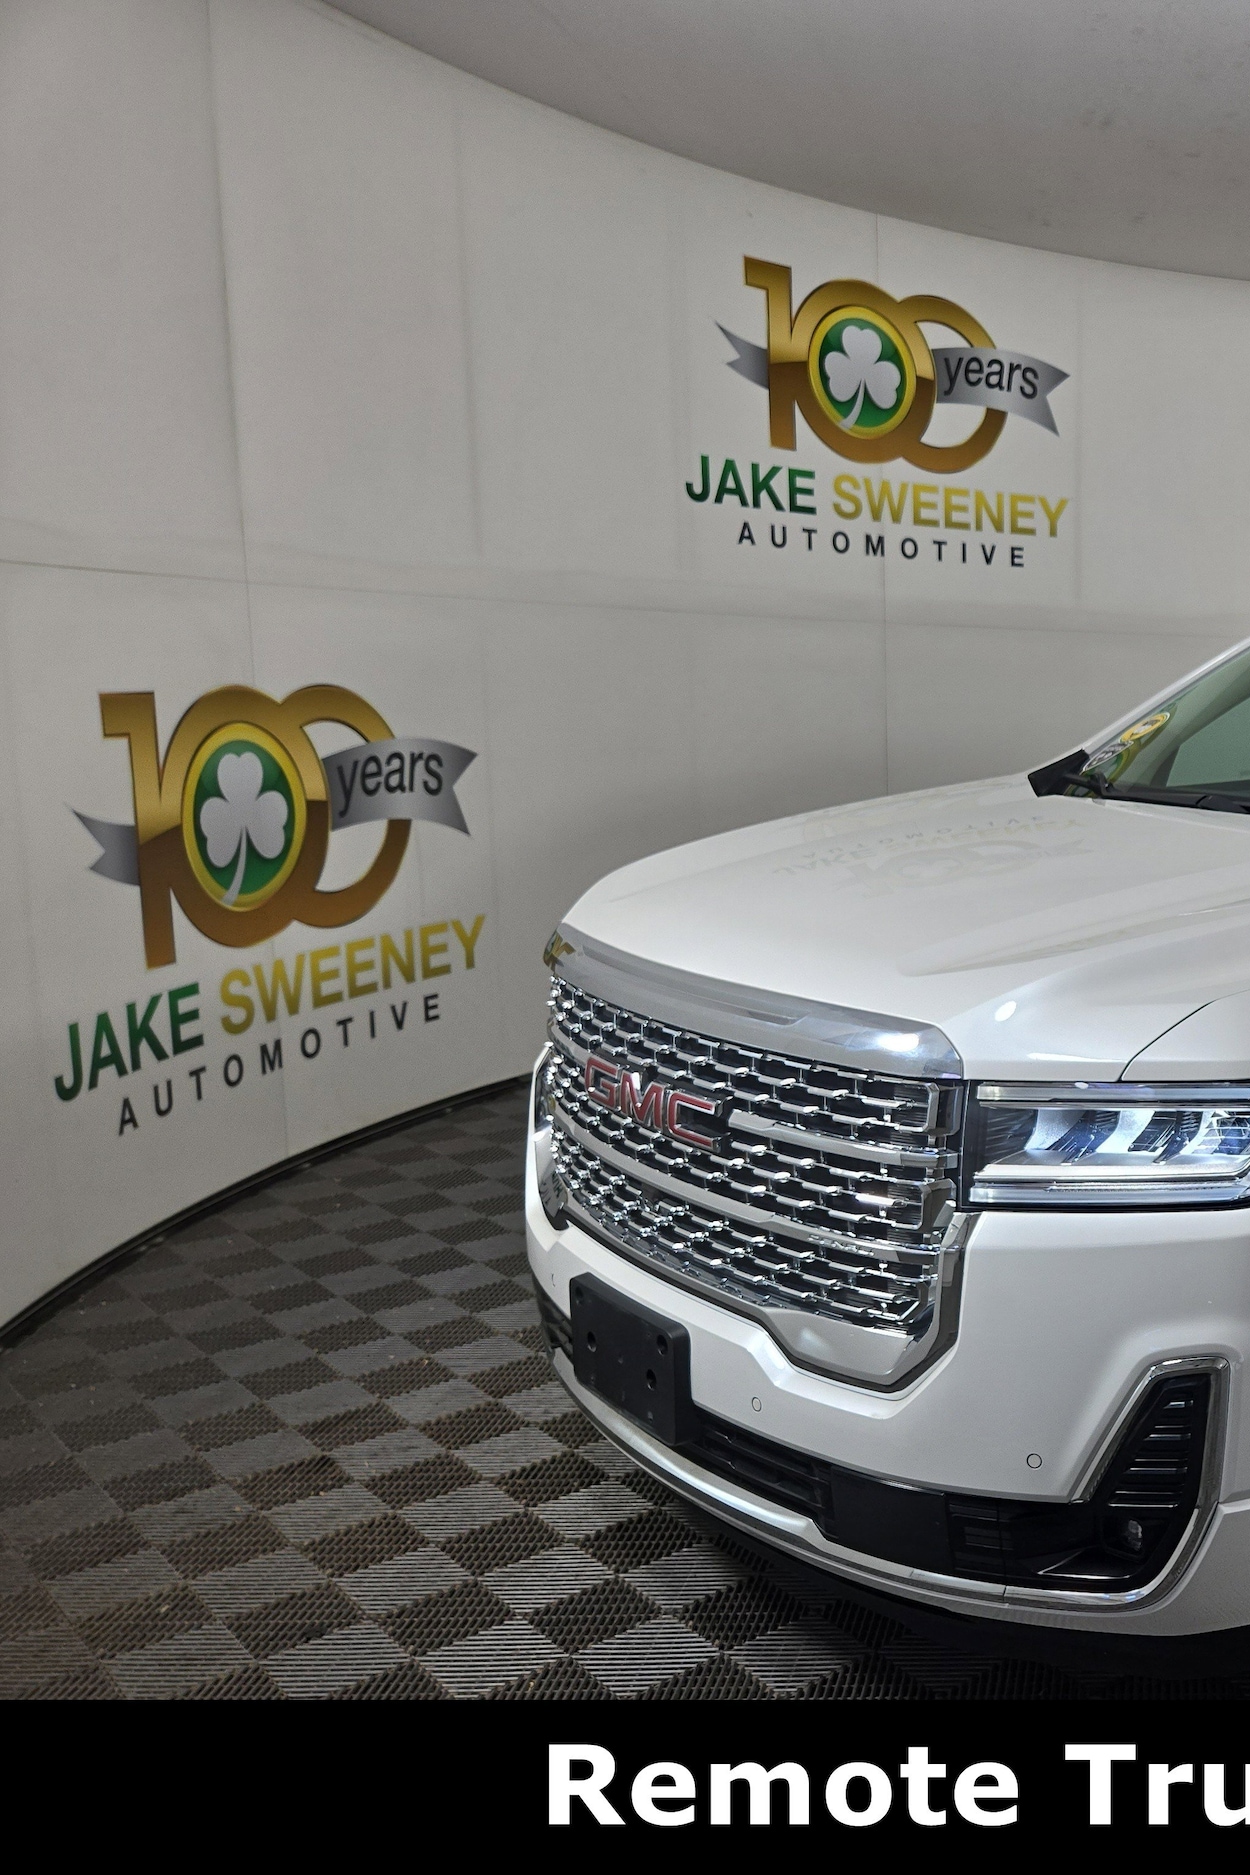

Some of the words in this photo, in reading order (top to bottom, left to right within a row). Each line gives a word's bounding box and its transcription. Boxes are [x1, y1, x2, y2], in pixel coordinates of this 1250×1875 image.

[943, 354, 1039, 401] years
[685, 454, 817, 516] JAKE
[832, 473, 1069, 538] SWEENEY
[737, 521, 1025, 568] AUTOMOTIVE
[336, 750, 444, 817] years
[54, 982, 205, 1102] JAKE
[219, 914, 487, 1036] SWEENEY
[118, 994, 441, 1136] AUTOMOTIVE
[584, 1056, 718, 1151] GMC
